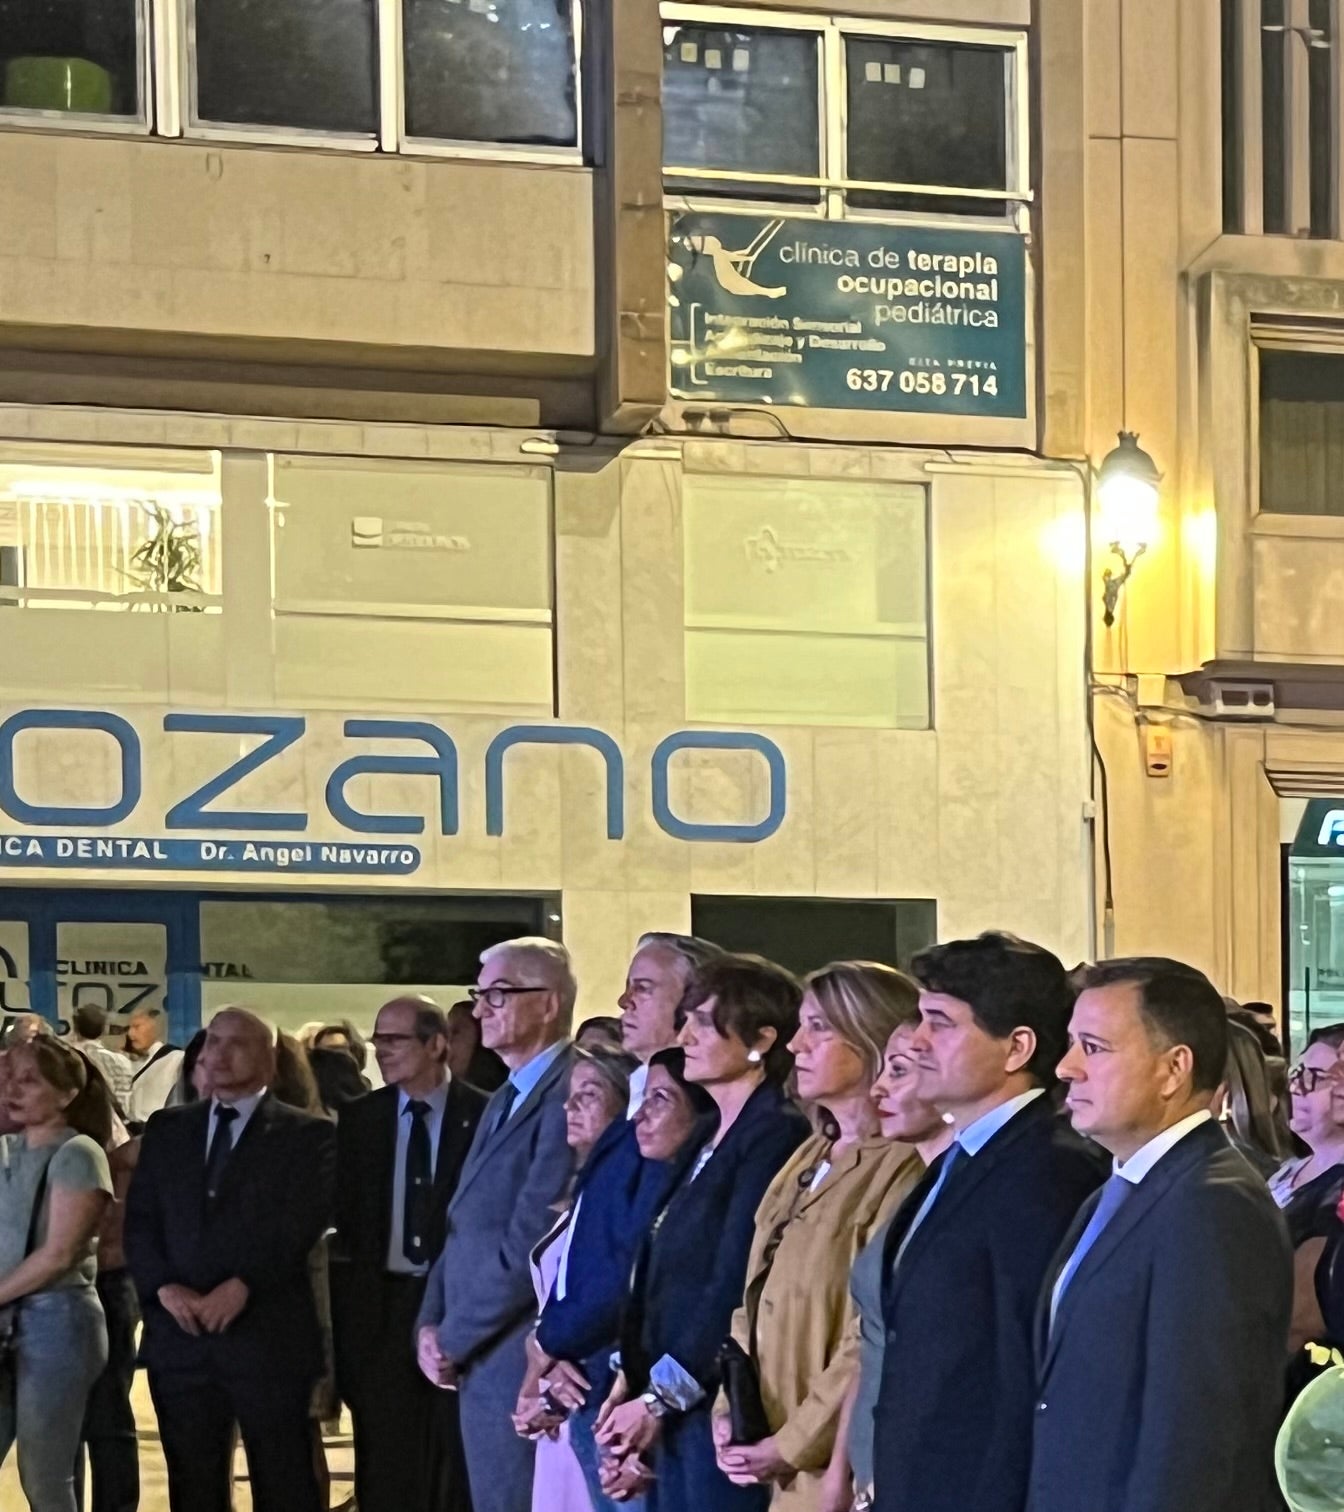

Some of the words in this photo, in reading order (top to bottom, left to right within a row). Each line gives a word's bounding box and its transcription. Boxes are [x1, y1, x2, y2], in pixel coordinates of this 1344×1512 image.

[868, 247, 900, 269] de
[908, 249, 998, 278] terapia
[837, 275, 998, 301] ocupacional
[875, 301, 998, 327] pediátrica
[847, 368, 894, 392] 637
[899, 370, 947, 395] 058
[951, 373, 998, 396] 714
[57, 838, 168, 860] DENTAL
[201, 842, 235, 861] Dr.
[243, 842, 312, 866] Angel
[321, 845, 414, 866] Navarro
